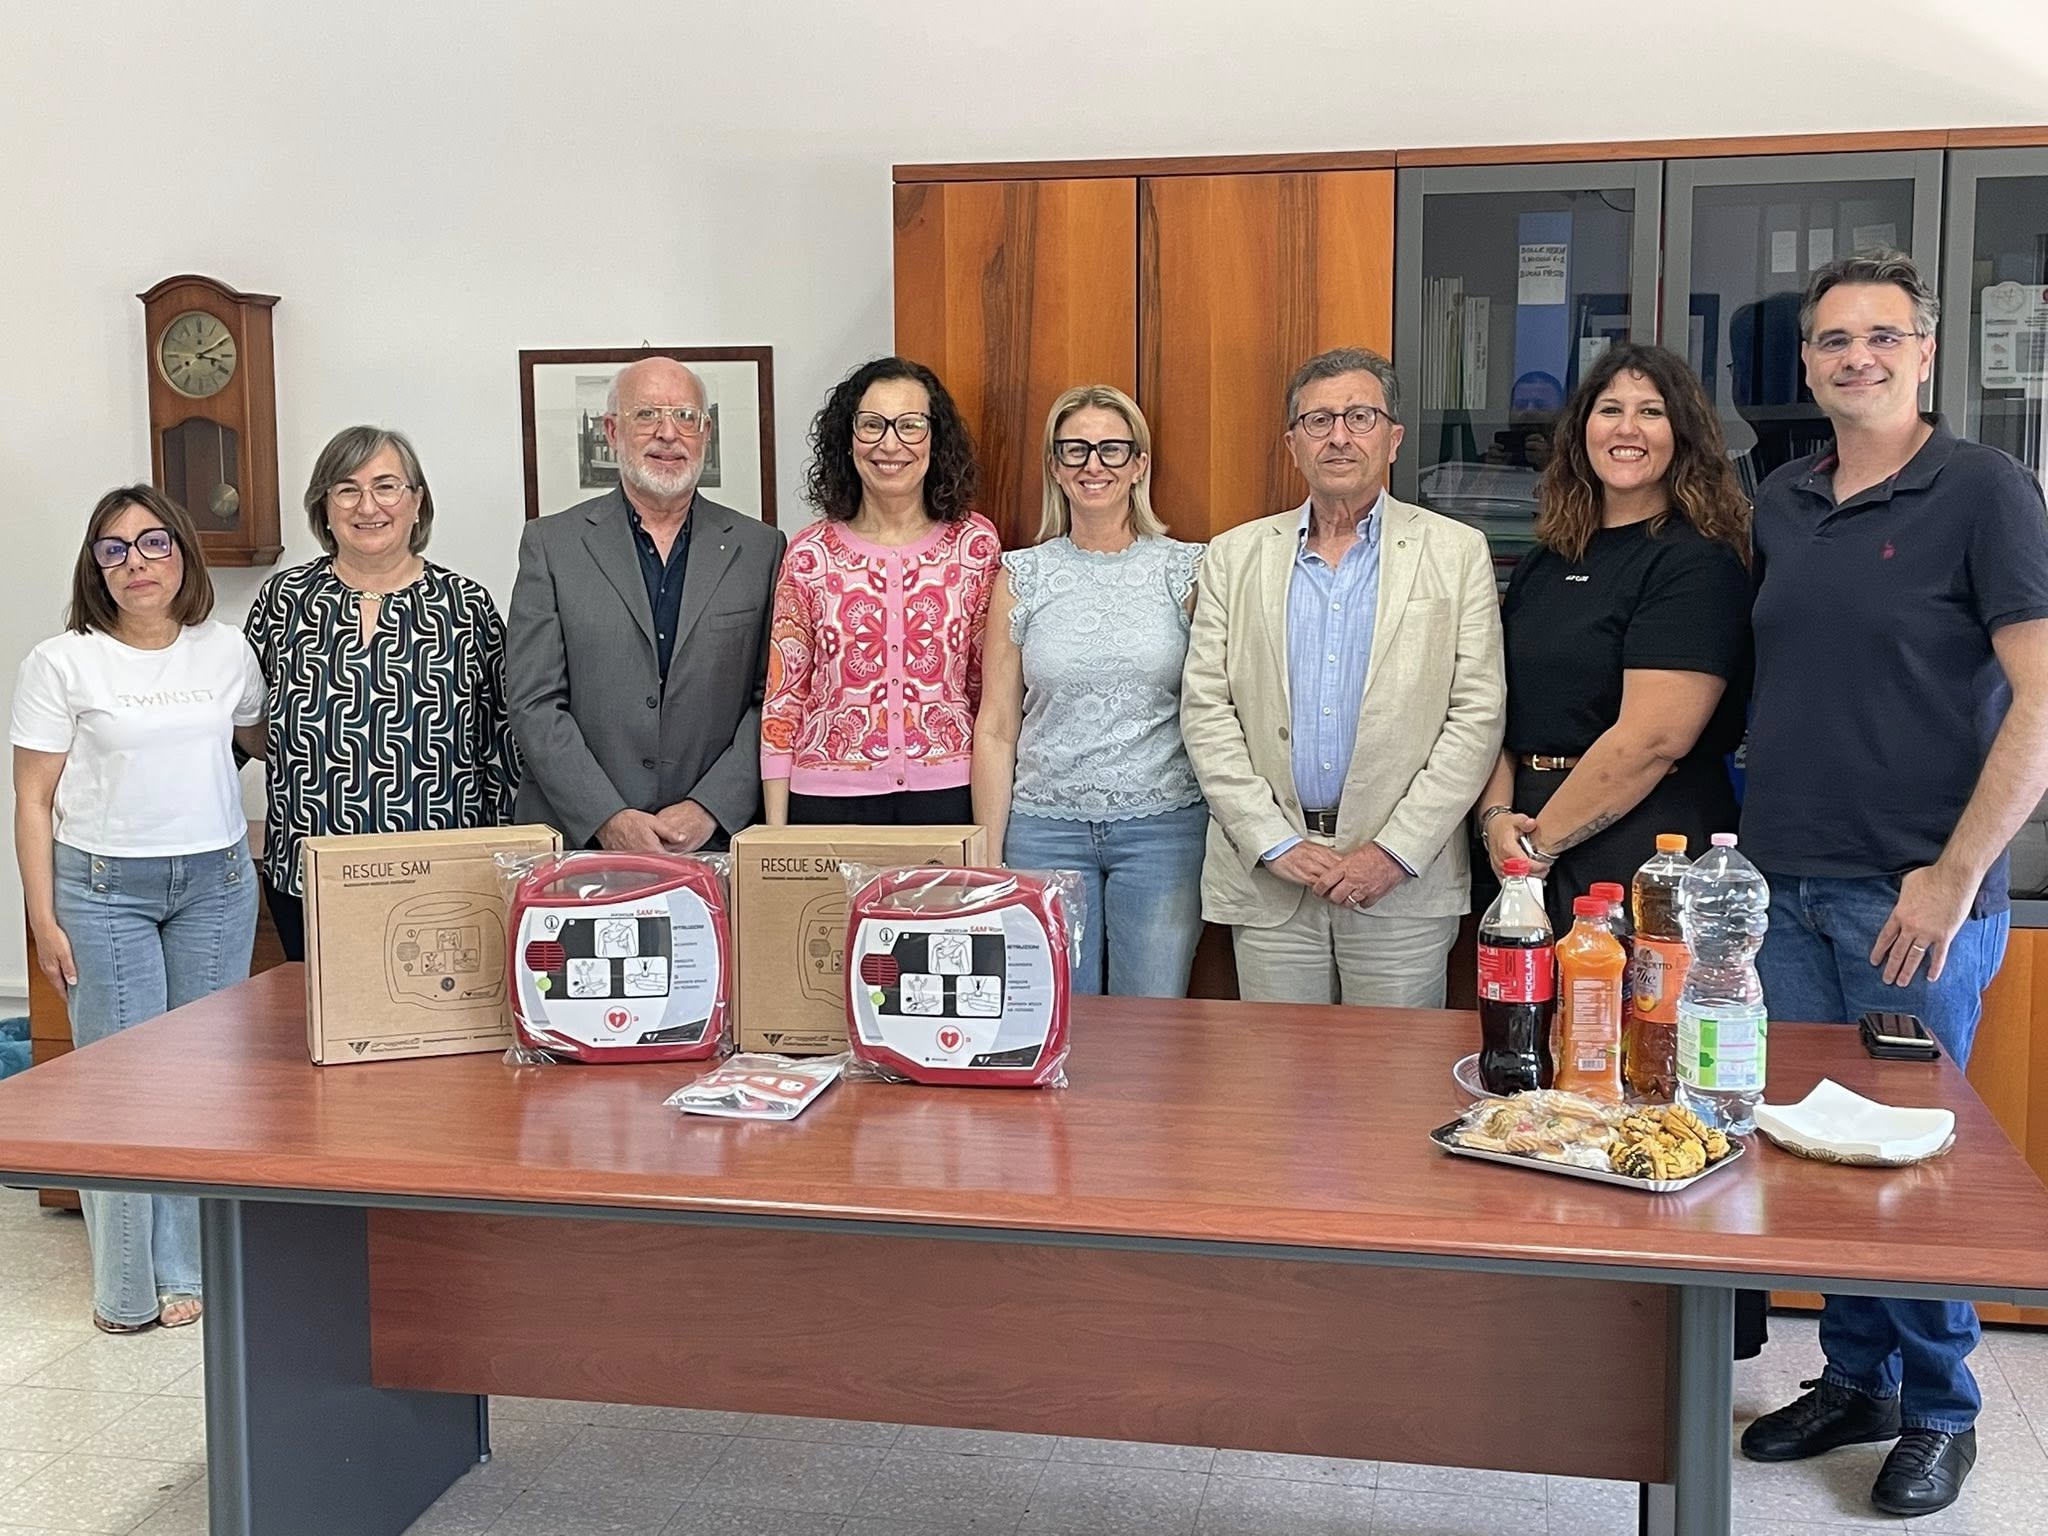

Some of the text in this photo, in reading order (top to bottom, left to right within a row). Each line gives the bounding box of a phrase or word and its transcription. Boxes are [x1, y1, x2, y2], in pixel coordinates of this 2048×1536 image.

[117, 689, 213, 707] TWINSET
[342, 860, 431, 879] RESCUE SAM
[761, 857, 809, 872] RESCUE
